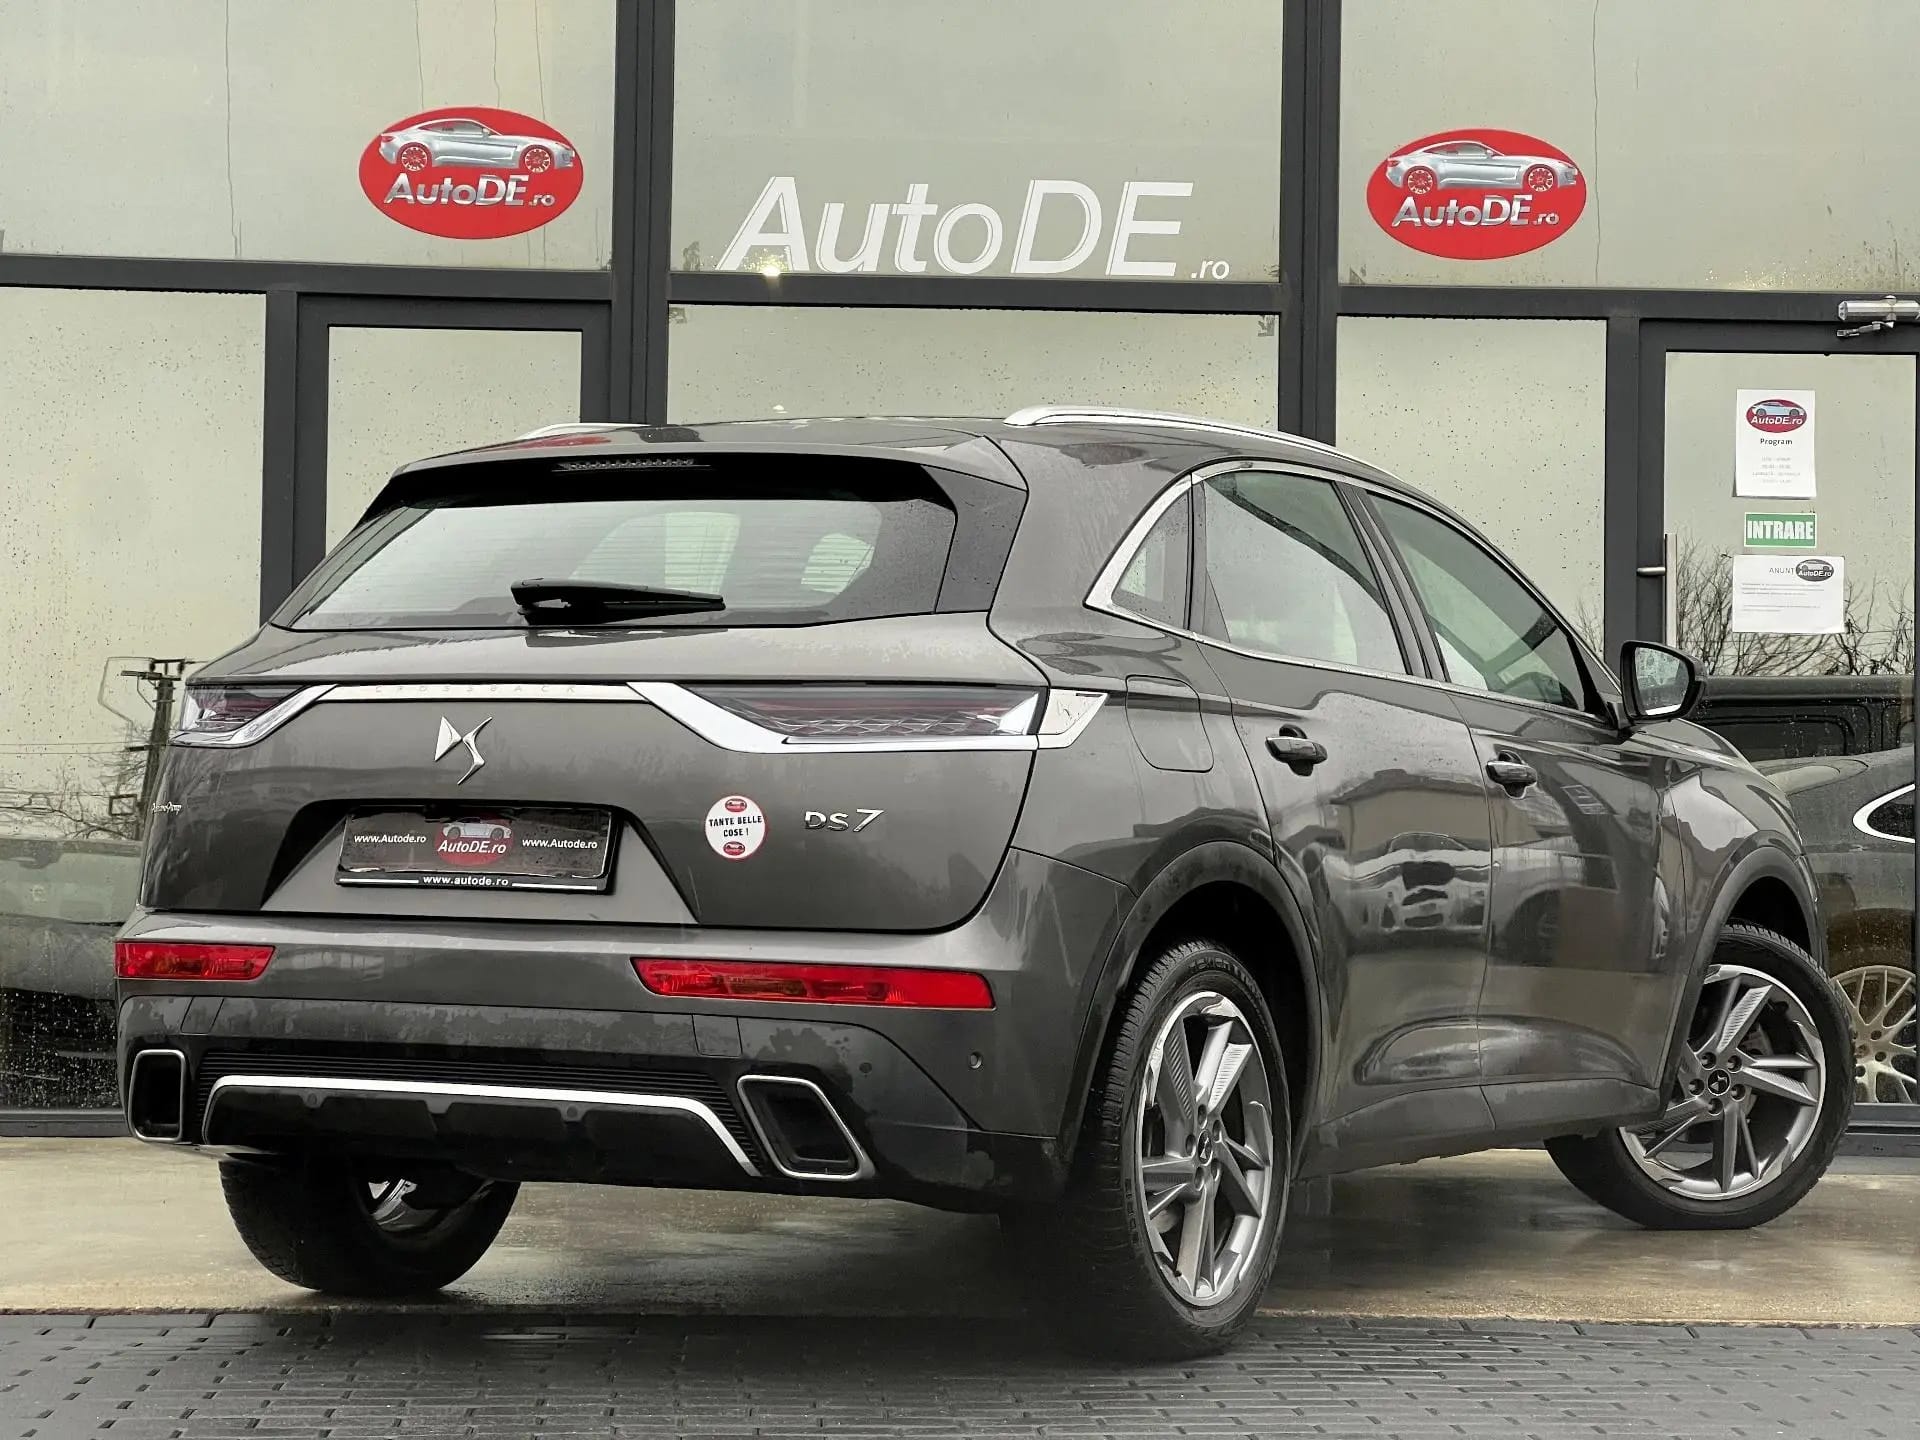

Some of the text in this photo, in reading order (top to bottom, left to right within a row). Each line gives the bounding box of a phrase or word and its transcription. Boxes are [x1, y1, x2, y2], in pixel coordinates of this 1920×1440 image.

[1750, 415, 1803, 425] AutoDE.ro
[1760, 438, 1793, 447] Program
[1747, 520, 1815, 540] INTRARE
[709, 815, 763, 827] TANTE BELLE
[354, 833, 427, 844] www.Autode.ro
[723, 828, 744, 837] COSE
[437, 839, 507, 854] AutoDE.ro
[522, 838, 598, 850] www.Autode.ro
[422, 875, 509, 887] www.autode.ro
